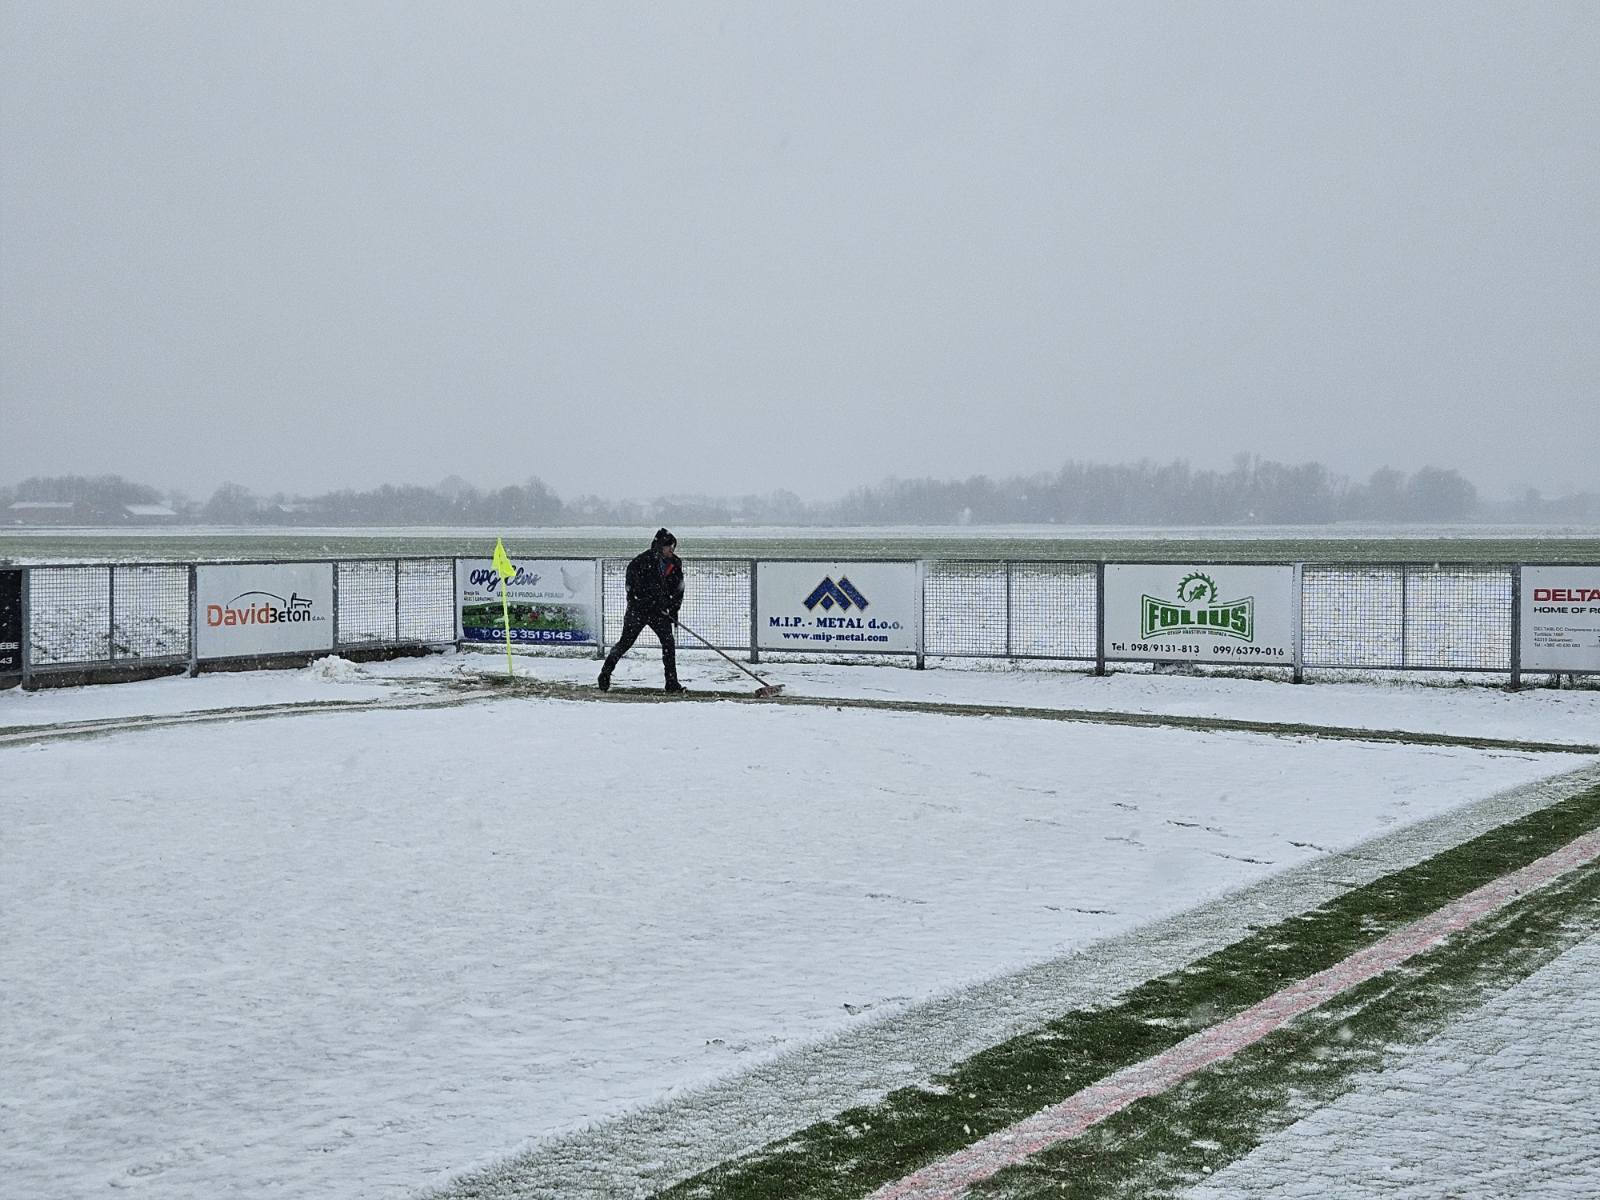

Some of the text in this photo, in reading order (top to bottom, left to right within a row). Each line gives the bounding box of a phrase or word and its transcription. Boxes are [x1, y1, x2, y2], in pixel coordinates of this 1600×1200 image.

[1534, 589, 1600, 601] DELTA
[769, 617, 805, 627] M.I.P.
[816, 618, 864, 628] METAL
[868, 619, 903, 629] d.o.o.
[1149, 603, 1247, 633] FOLIUS
[520, 629, 541, 639] 351
[543, 631, 572, 639] 5145
[782, 632, 888, 642] www.mip-metal.com
[1112, 643, 1200, 653] Tel. 098/9131-813
[1213, 645, 1284, 656] 099/6379-016
